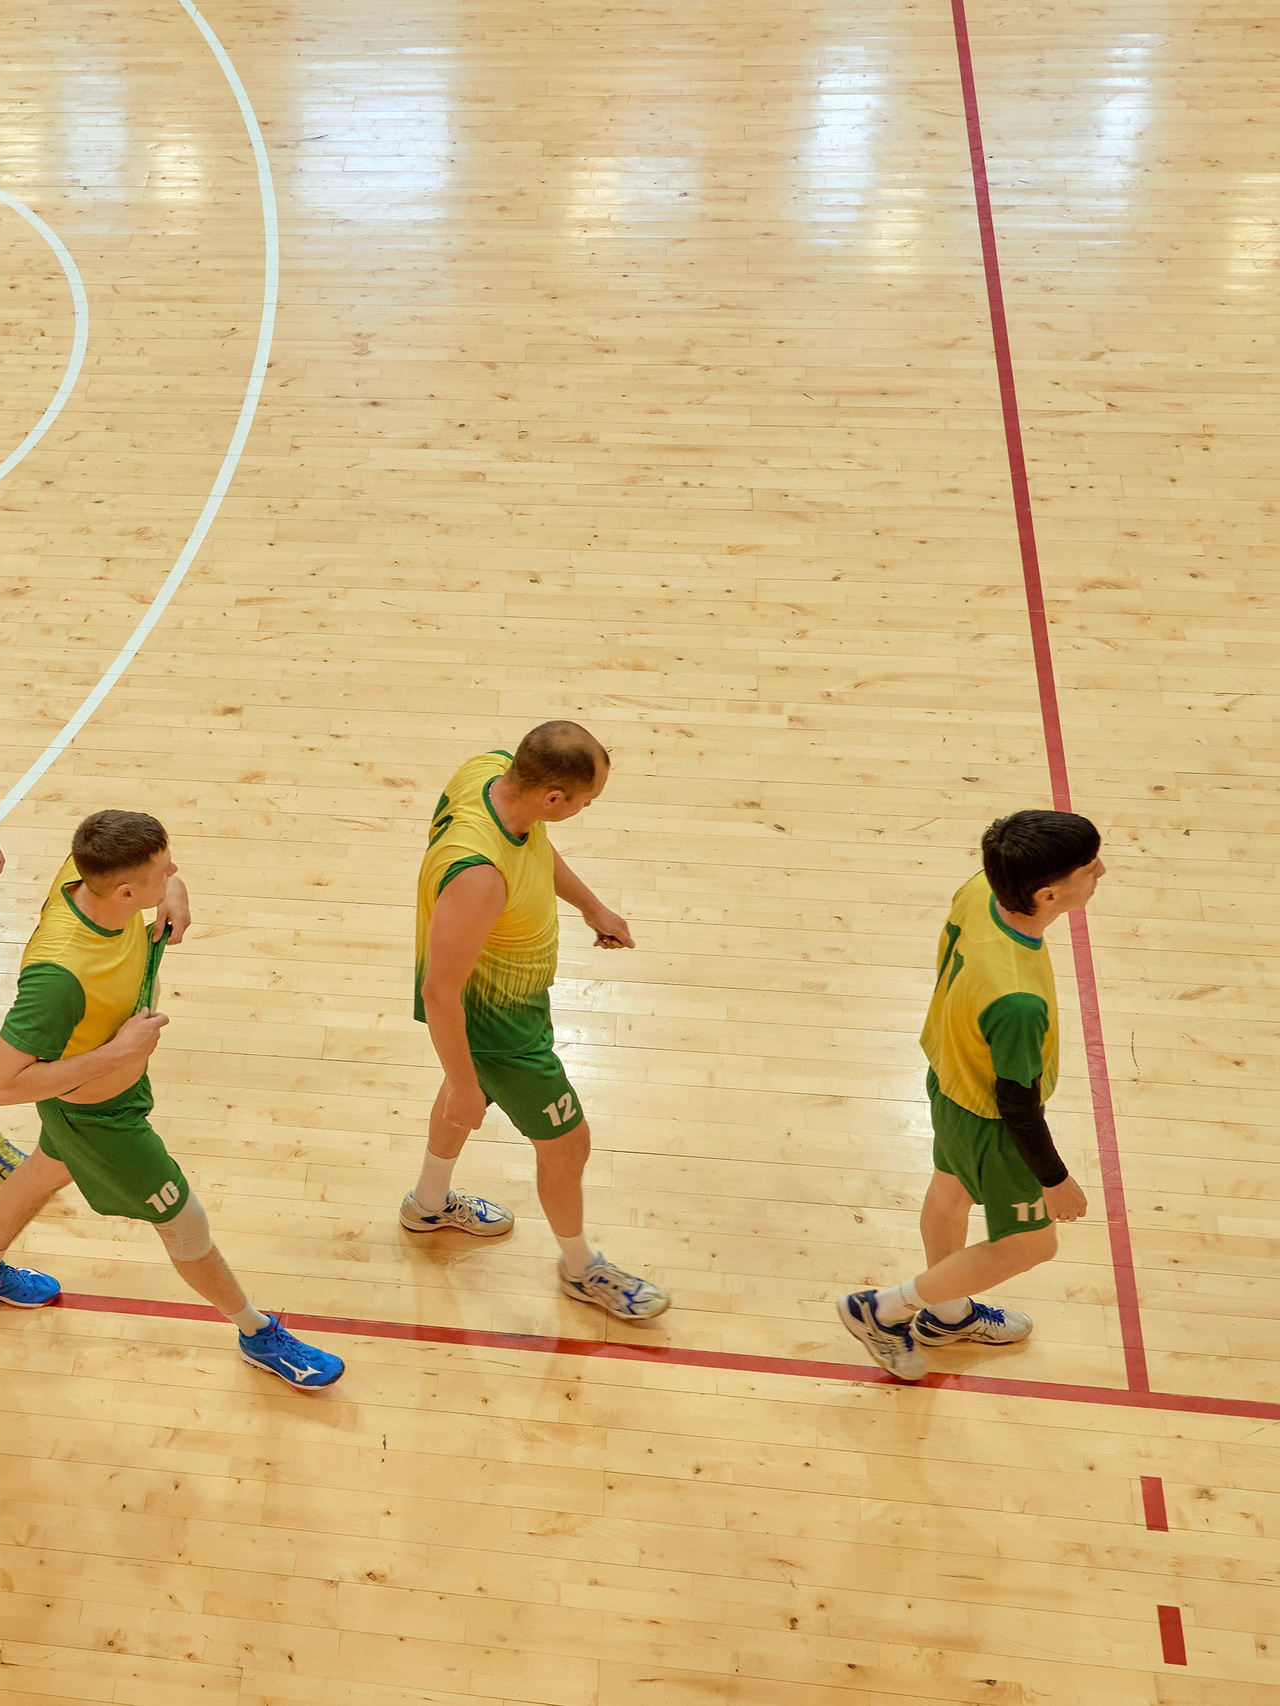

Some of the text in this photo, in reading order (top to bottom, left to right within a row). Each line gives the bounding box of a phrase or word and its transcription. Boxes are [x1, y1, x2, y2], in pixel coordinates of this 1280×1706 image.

[541, 1092, 577, 1127] 12
[144, 1180, 180, 1214] 10
[1010, 1196, 1046, 1222] 11
